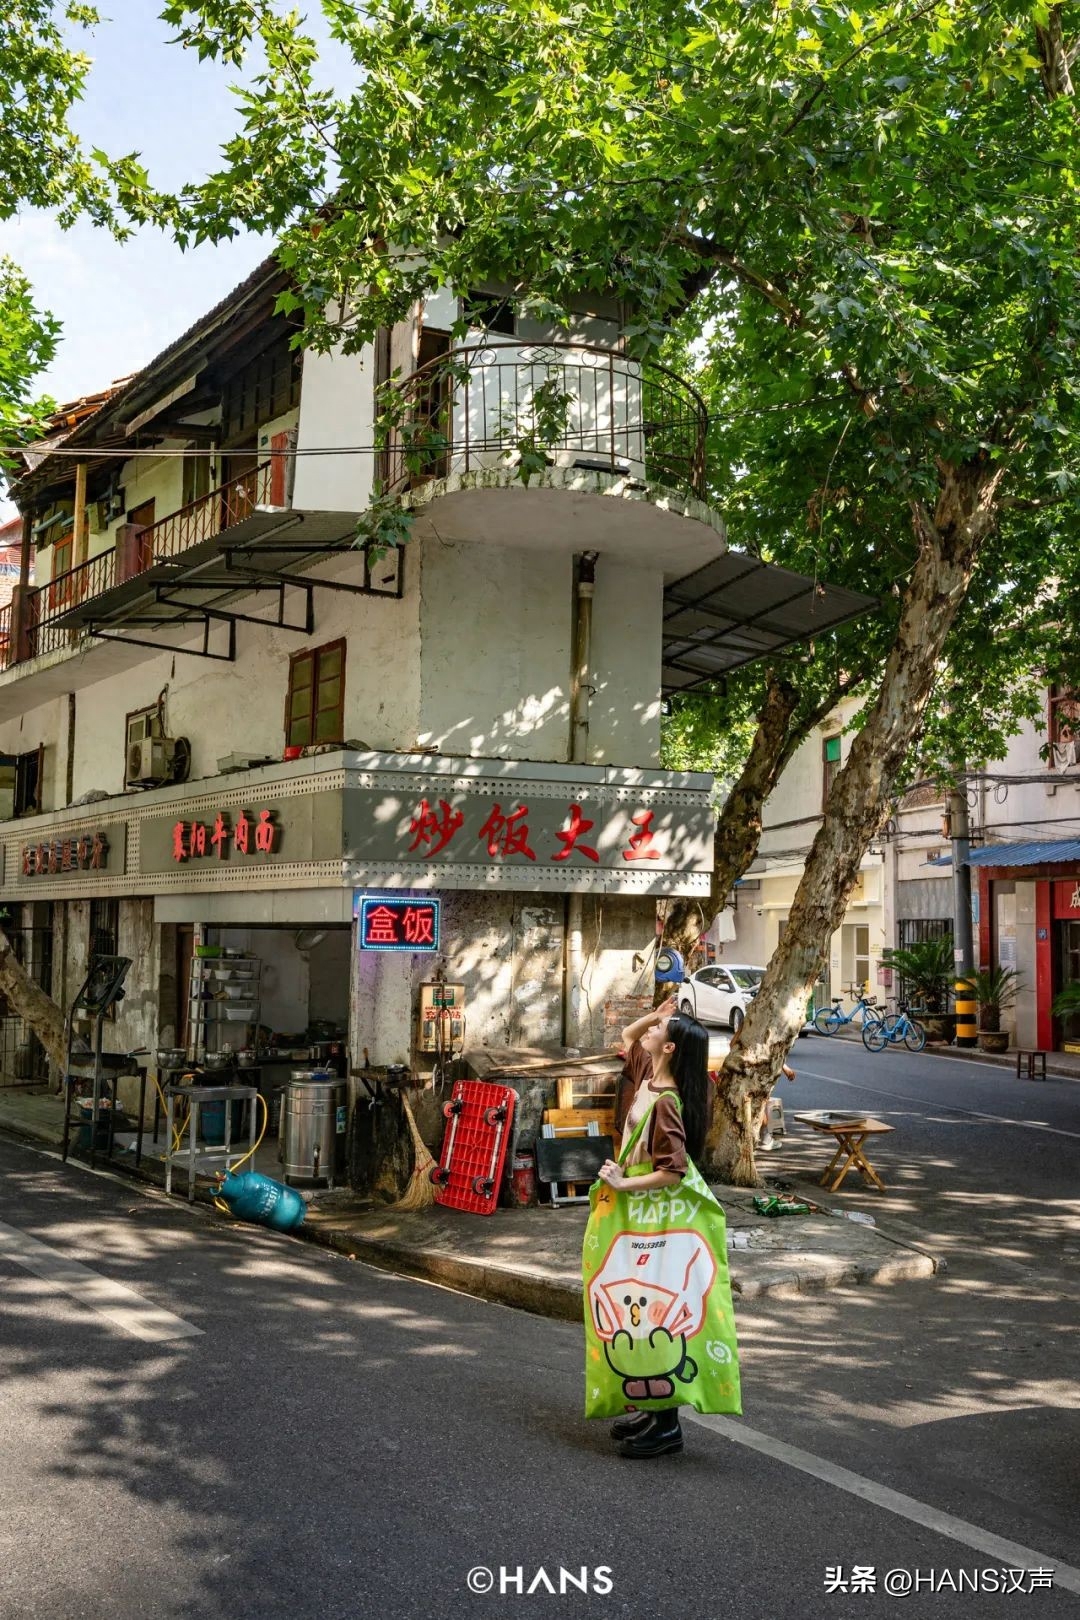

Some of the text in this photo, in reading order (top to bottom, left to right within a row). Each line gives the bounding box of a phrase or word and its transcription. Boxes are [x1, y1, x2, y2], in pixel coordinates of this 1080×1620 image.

[172, 809, 275, 863] 襄阳牛肉面
[408, 799, 661, 863] 炒饭大王
[366, 906, 434, 943] 盒饭
[628, 1198, 702, 1224] HAPPY
